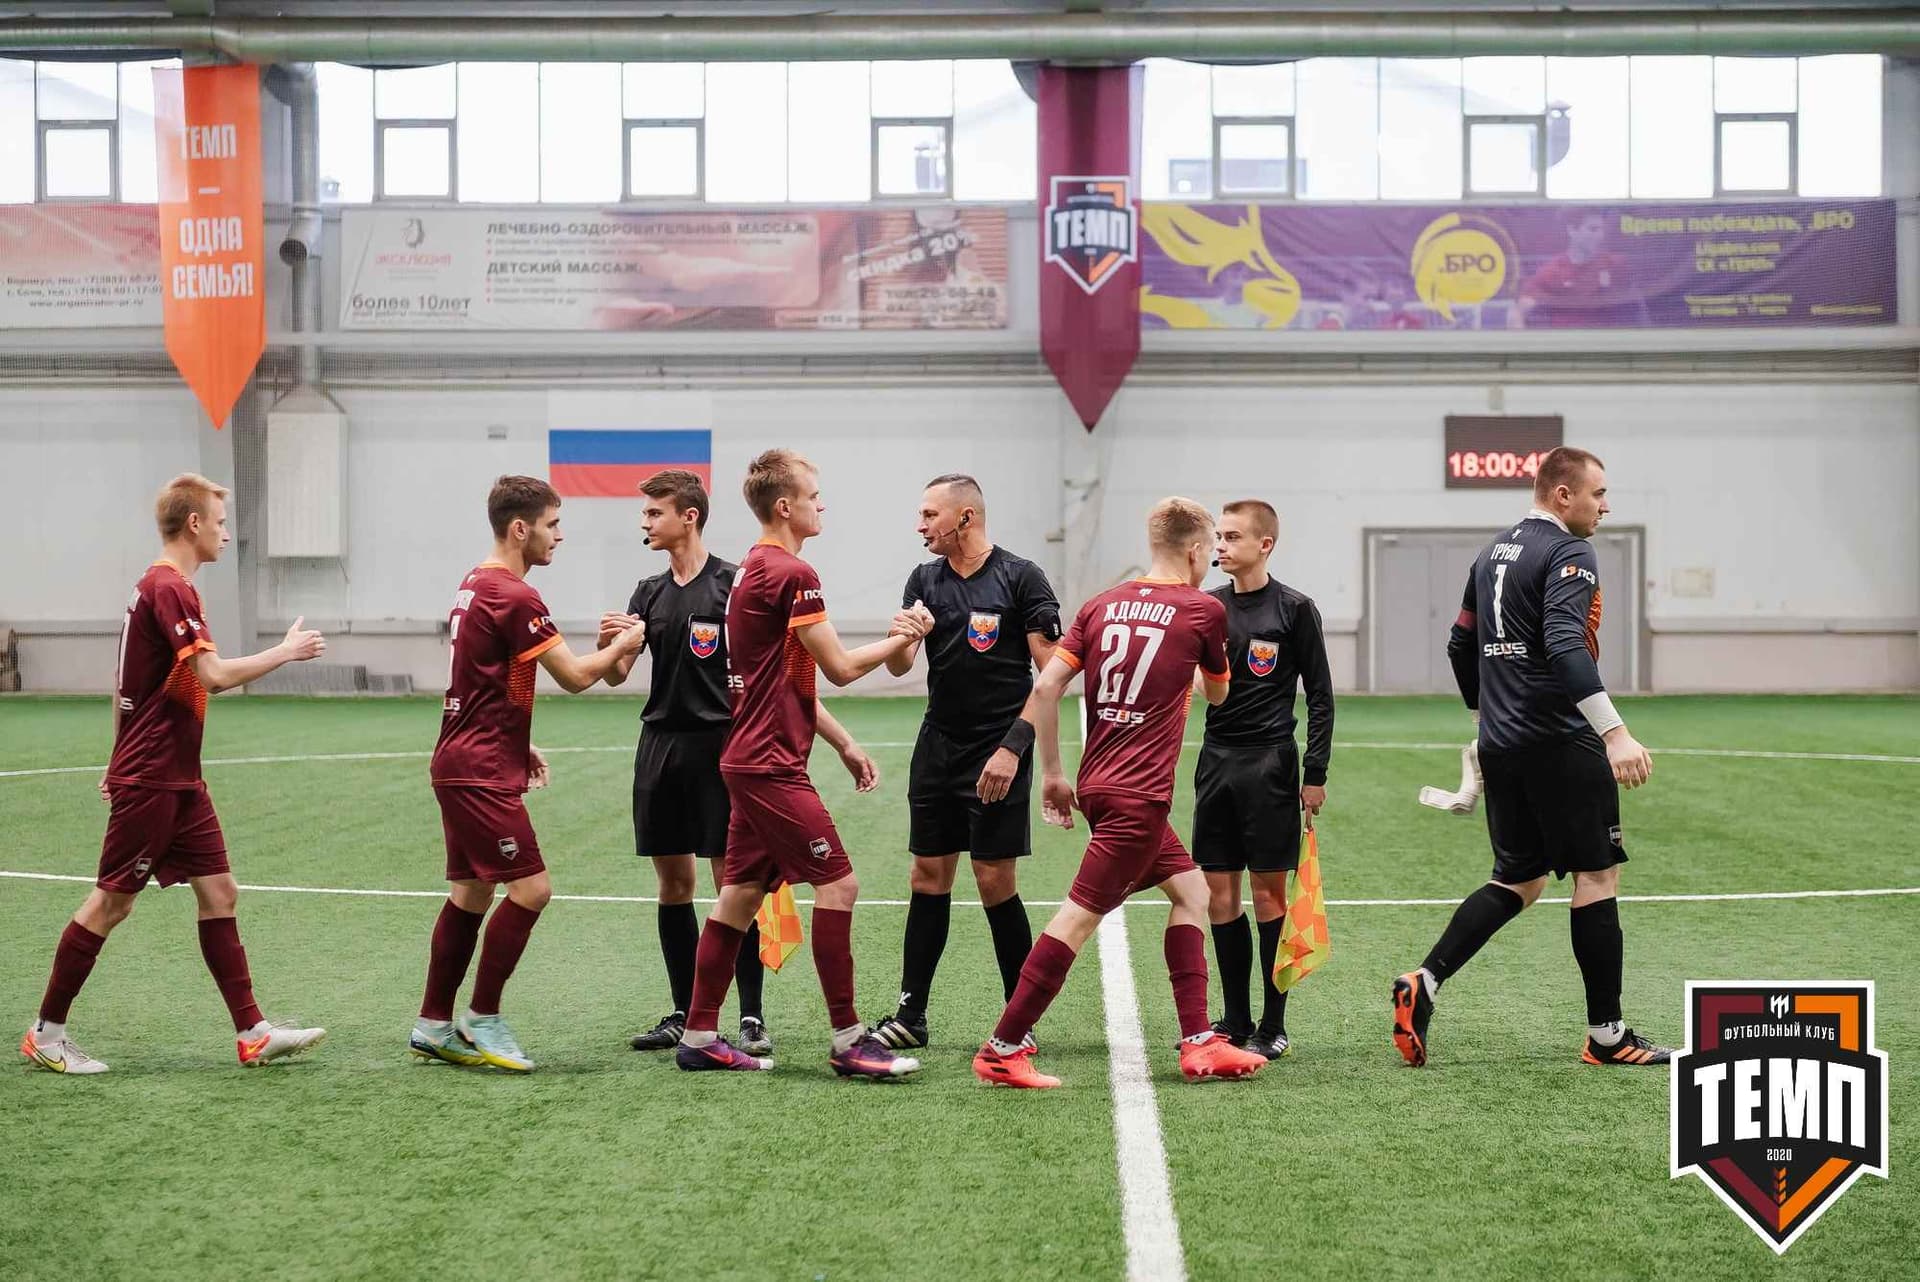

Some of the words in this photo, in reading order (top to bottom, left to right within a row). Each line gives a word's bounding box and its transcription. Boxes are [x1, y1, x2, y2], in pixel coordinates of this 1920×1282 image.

[179, 124, 237, 160] ТЕМП
[180, 216, 243, 256] ОДНА
[1053, 209, 1128, 249] ТЕМП
[173, 262, 253, 299] СЕМЬЯ!
[487, 261, 562, 274] ДЕТСКИЙ
[352, 294, 410, 309] более
[420, 294, 470, 309] 10лет
[1449, 451, 1547, 478] 18:00:4
[1103, 600, 1177, 627] ЖДАНОВ
[1493, 564, 1507, 638] 1
[1097, 623, 1166, 705] 27
